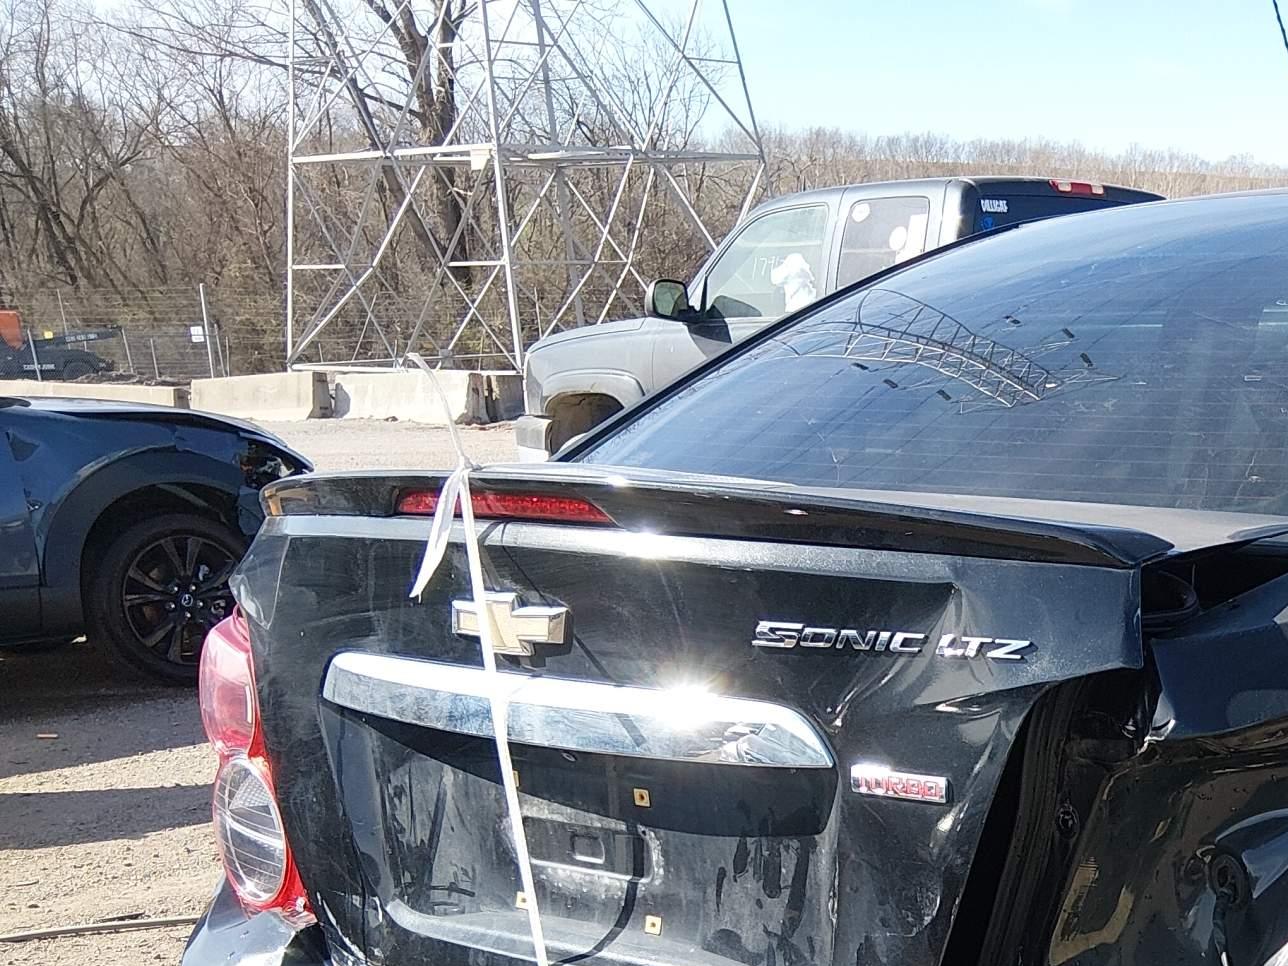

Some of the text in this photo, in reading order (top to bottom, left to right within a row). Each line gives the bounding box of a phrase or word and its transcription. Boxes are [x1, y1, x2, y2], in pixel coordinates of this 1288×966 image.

[751, 620, 1032, 660] SONIC LTZ
[856, 774, 941, 799] TURBO
